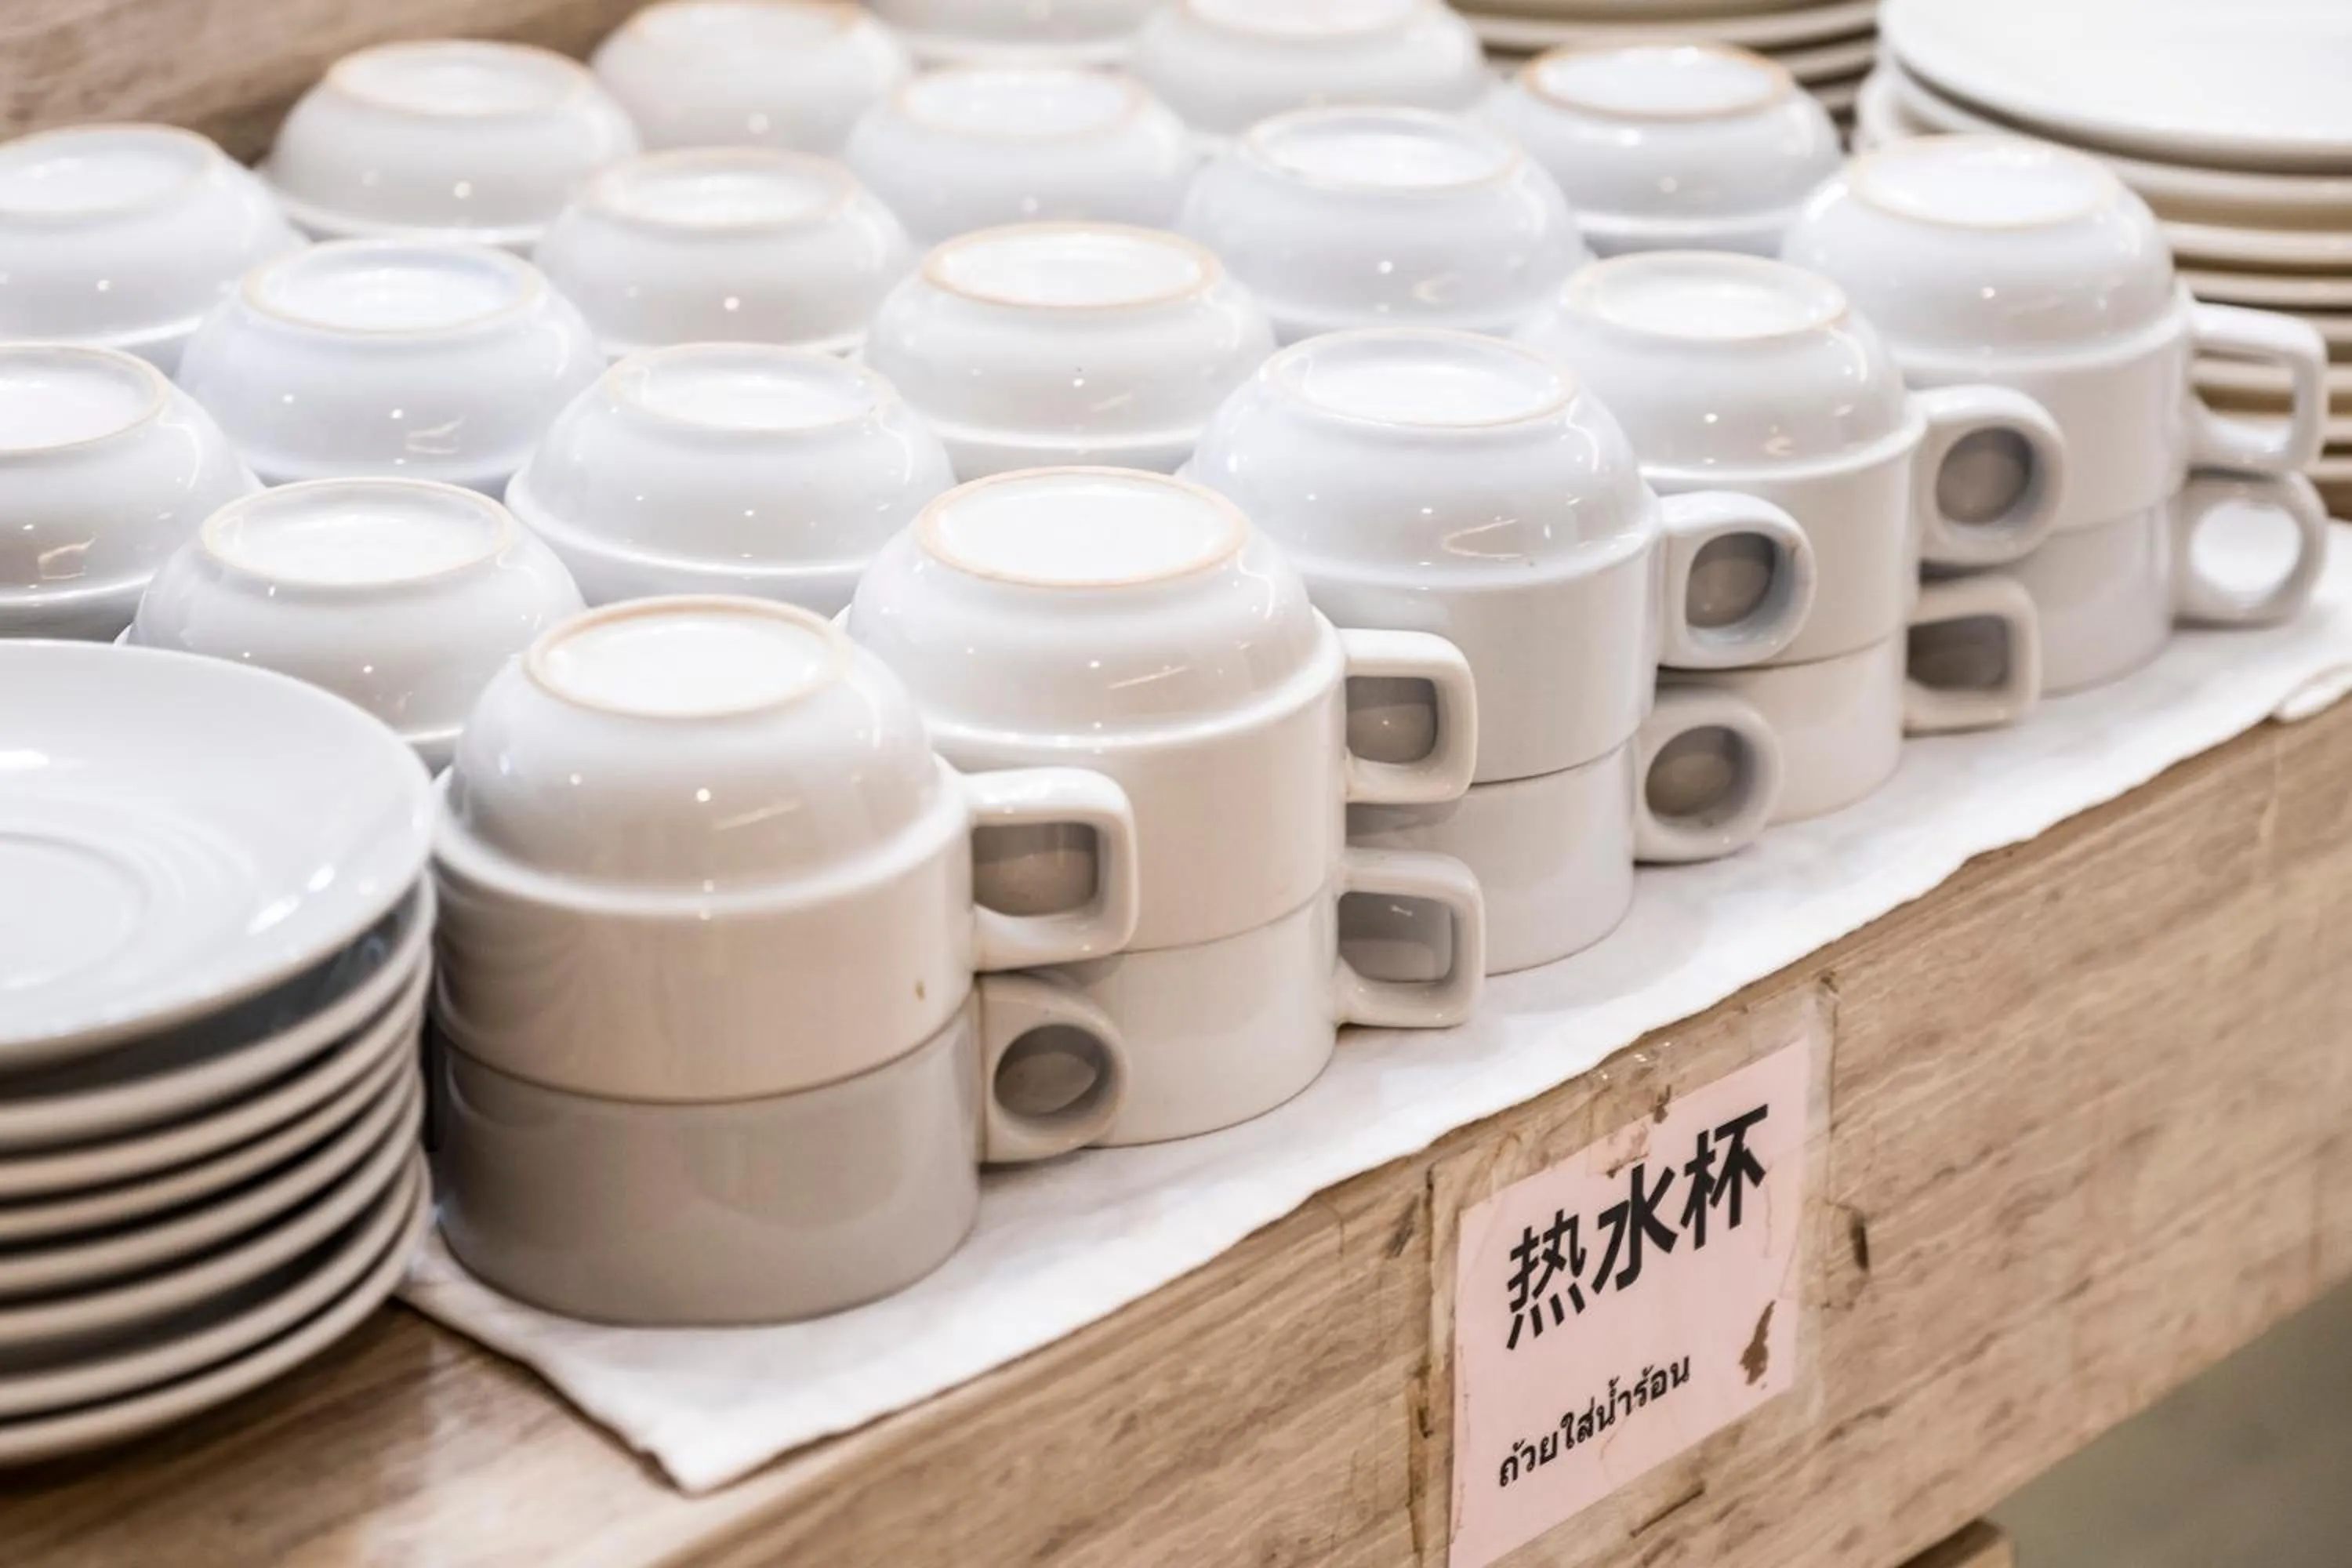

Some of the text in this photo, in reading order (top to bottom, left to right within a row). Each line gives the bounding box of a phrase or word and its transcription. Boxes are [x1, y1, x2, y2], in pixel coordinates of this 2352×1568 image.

[1506, 1104, 1769, 1351] 热水杯
[1499, 1356, 1690, 1487] ถ้วยใส่น้ำร้อน
